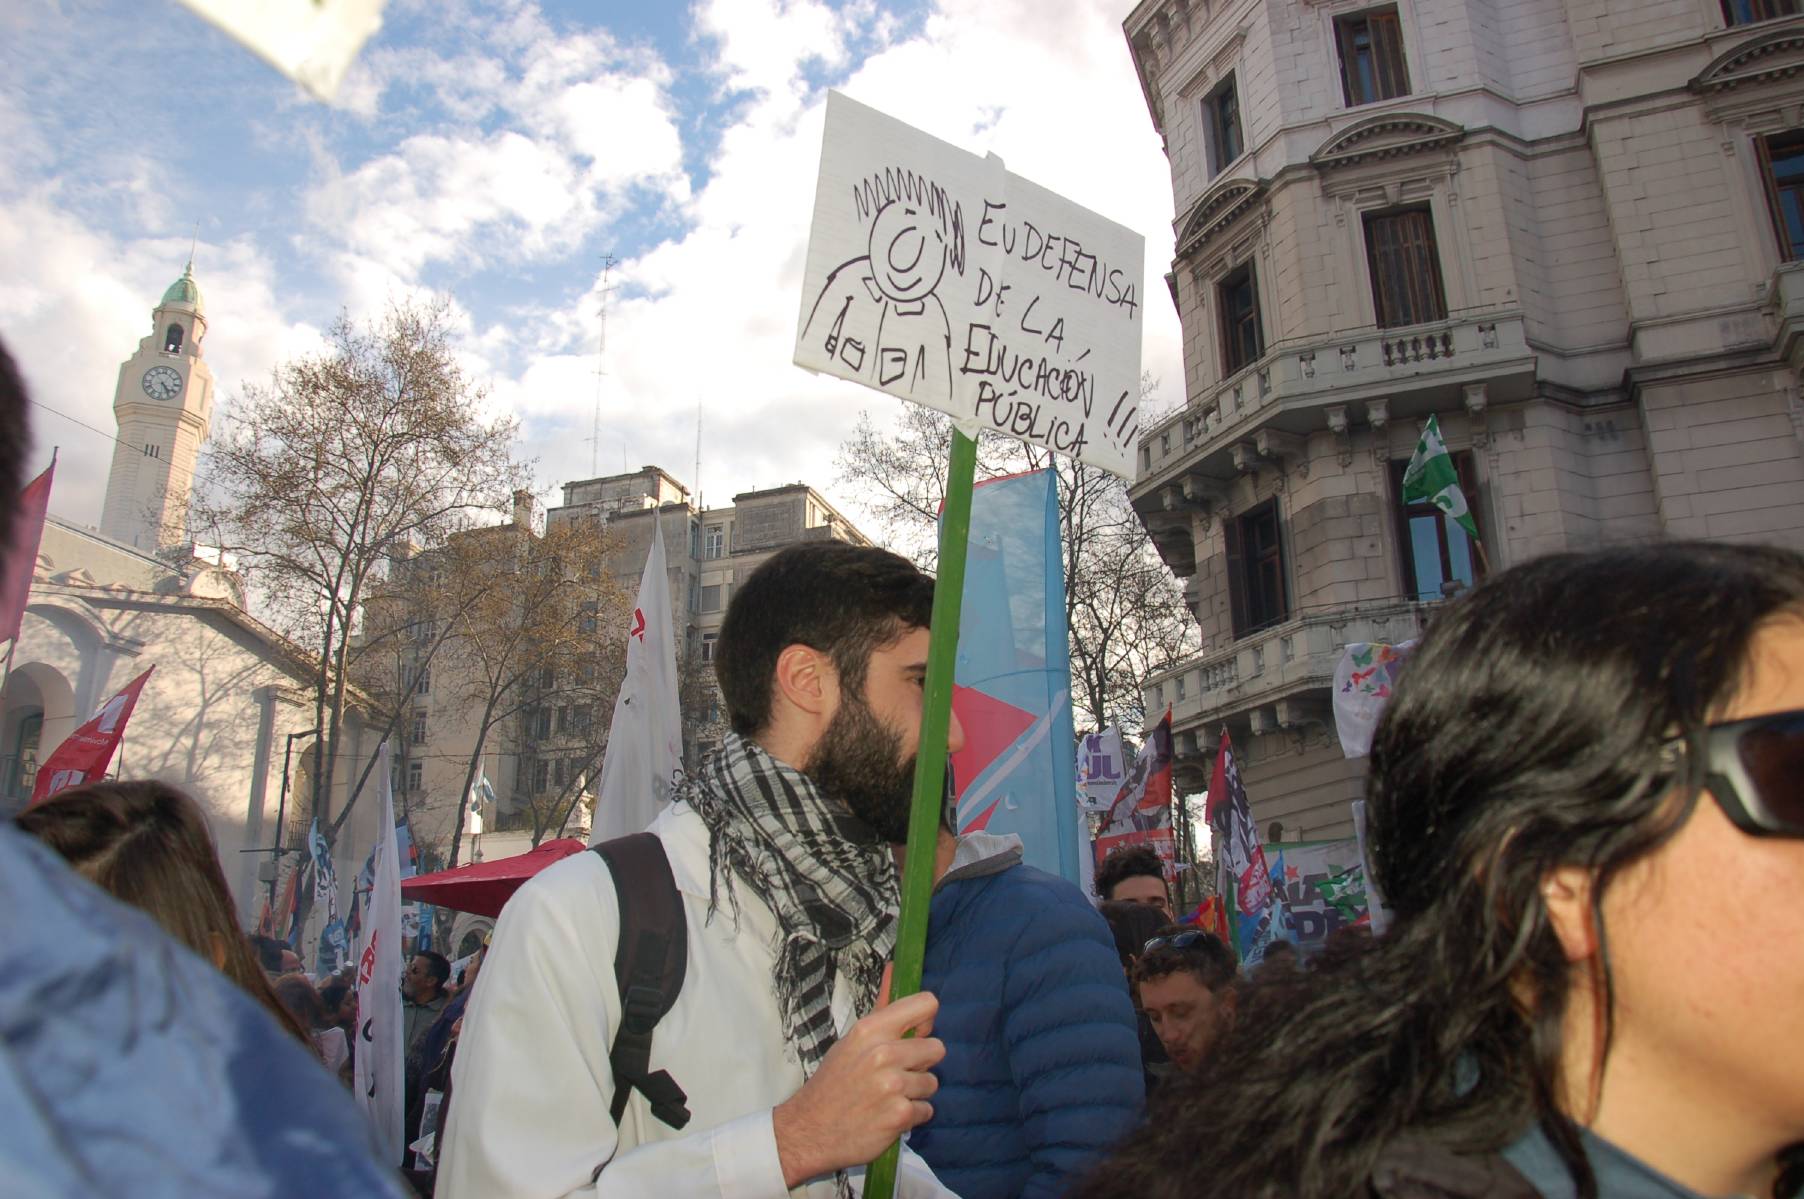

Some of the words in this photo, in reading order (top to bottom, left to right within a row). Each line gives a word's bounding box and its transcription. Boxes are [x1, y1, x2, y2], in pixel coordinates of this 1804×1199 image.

[974, 267, 1011, 318] DE
[1021, 296, 1064, 354] LA
[1022, 221, 1138, 320] DEFENSA
